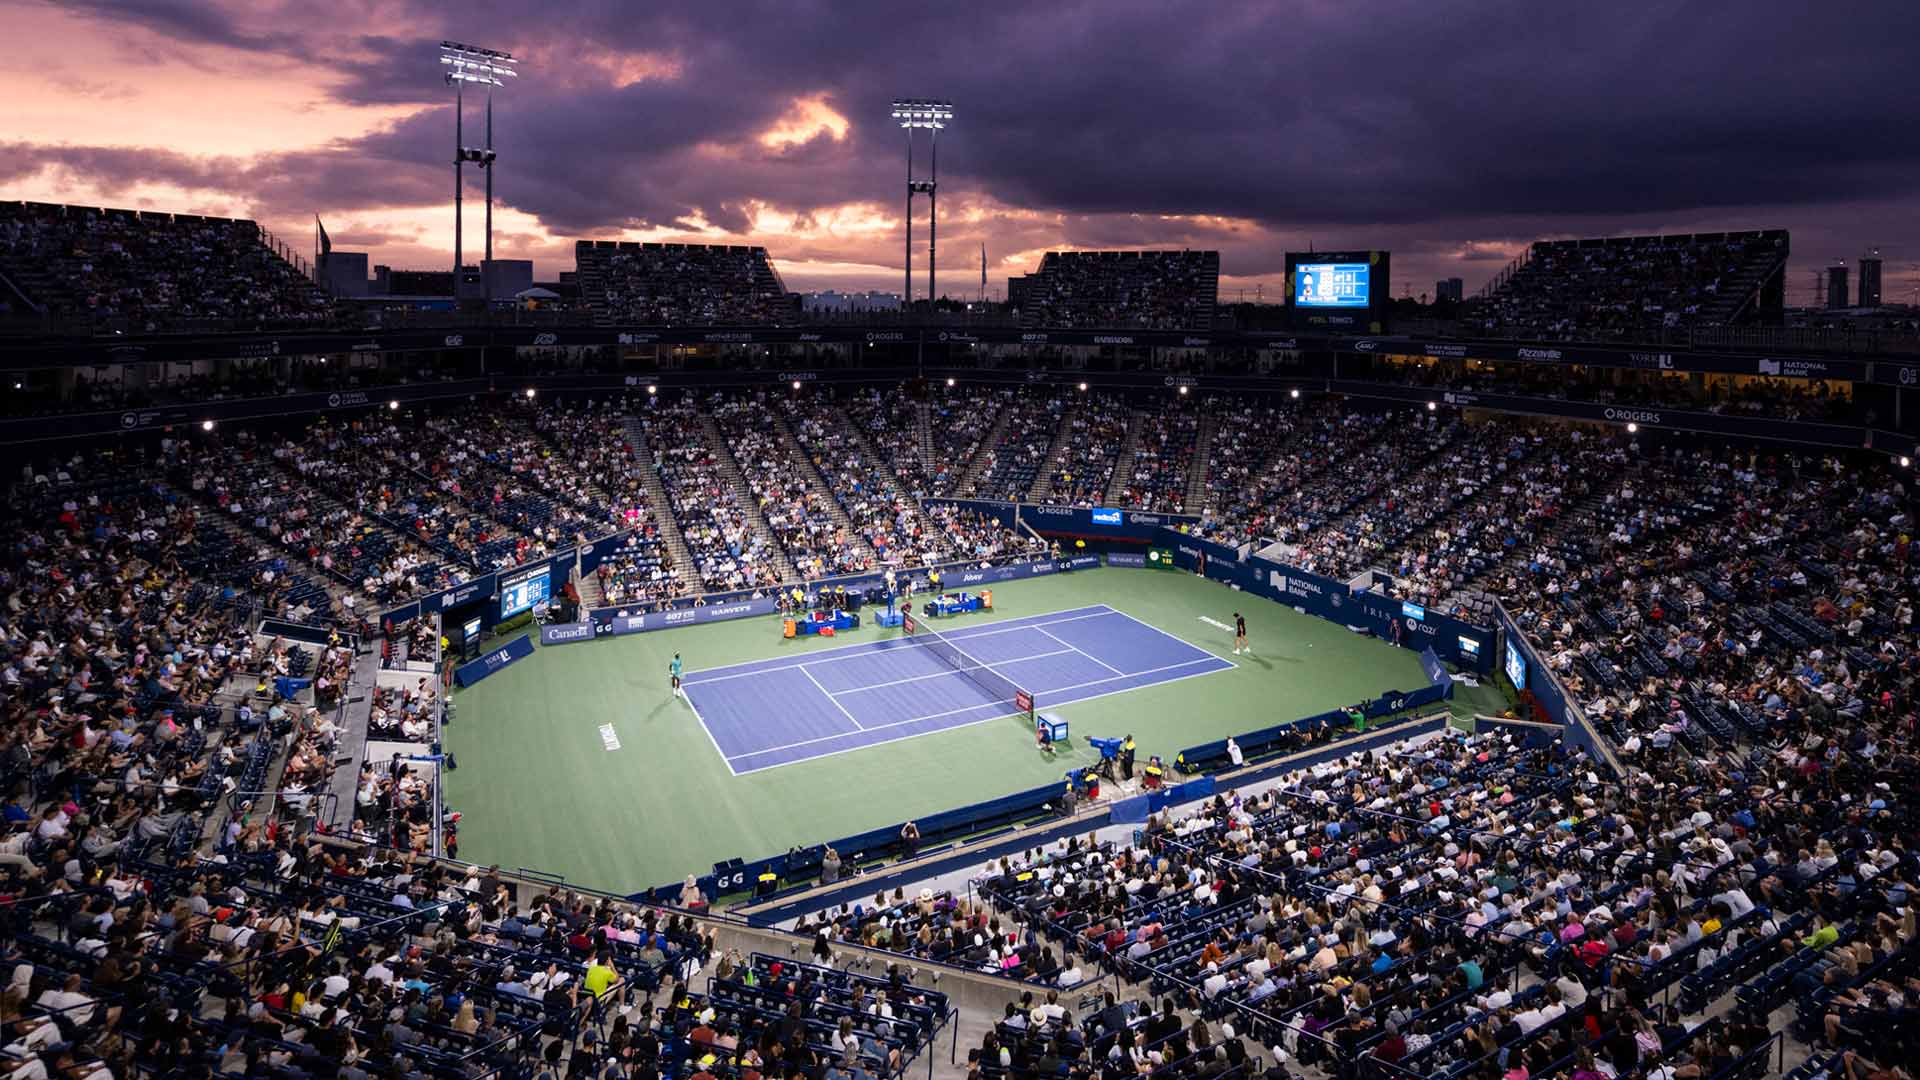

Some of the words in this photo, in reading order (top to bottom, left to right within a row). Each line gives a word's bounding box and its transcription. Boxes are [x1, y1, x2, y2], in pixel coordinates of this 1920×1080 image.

[1783, 360, 1827, 371] NATIONAL
[787, 372, 816, 380] ROGERS
[1783, 368, 1809, 377] BANK
[1617, 409, 1661, 424] ROGERS
[1046, 507, 1073, 516] ROGERS
[1288, 577, 1322, 594] NATIONAL
[1288, 585, 1309, 598] BANK
[665, 611, 682, 620] 407
[549, 627, 588, 640] Canada
